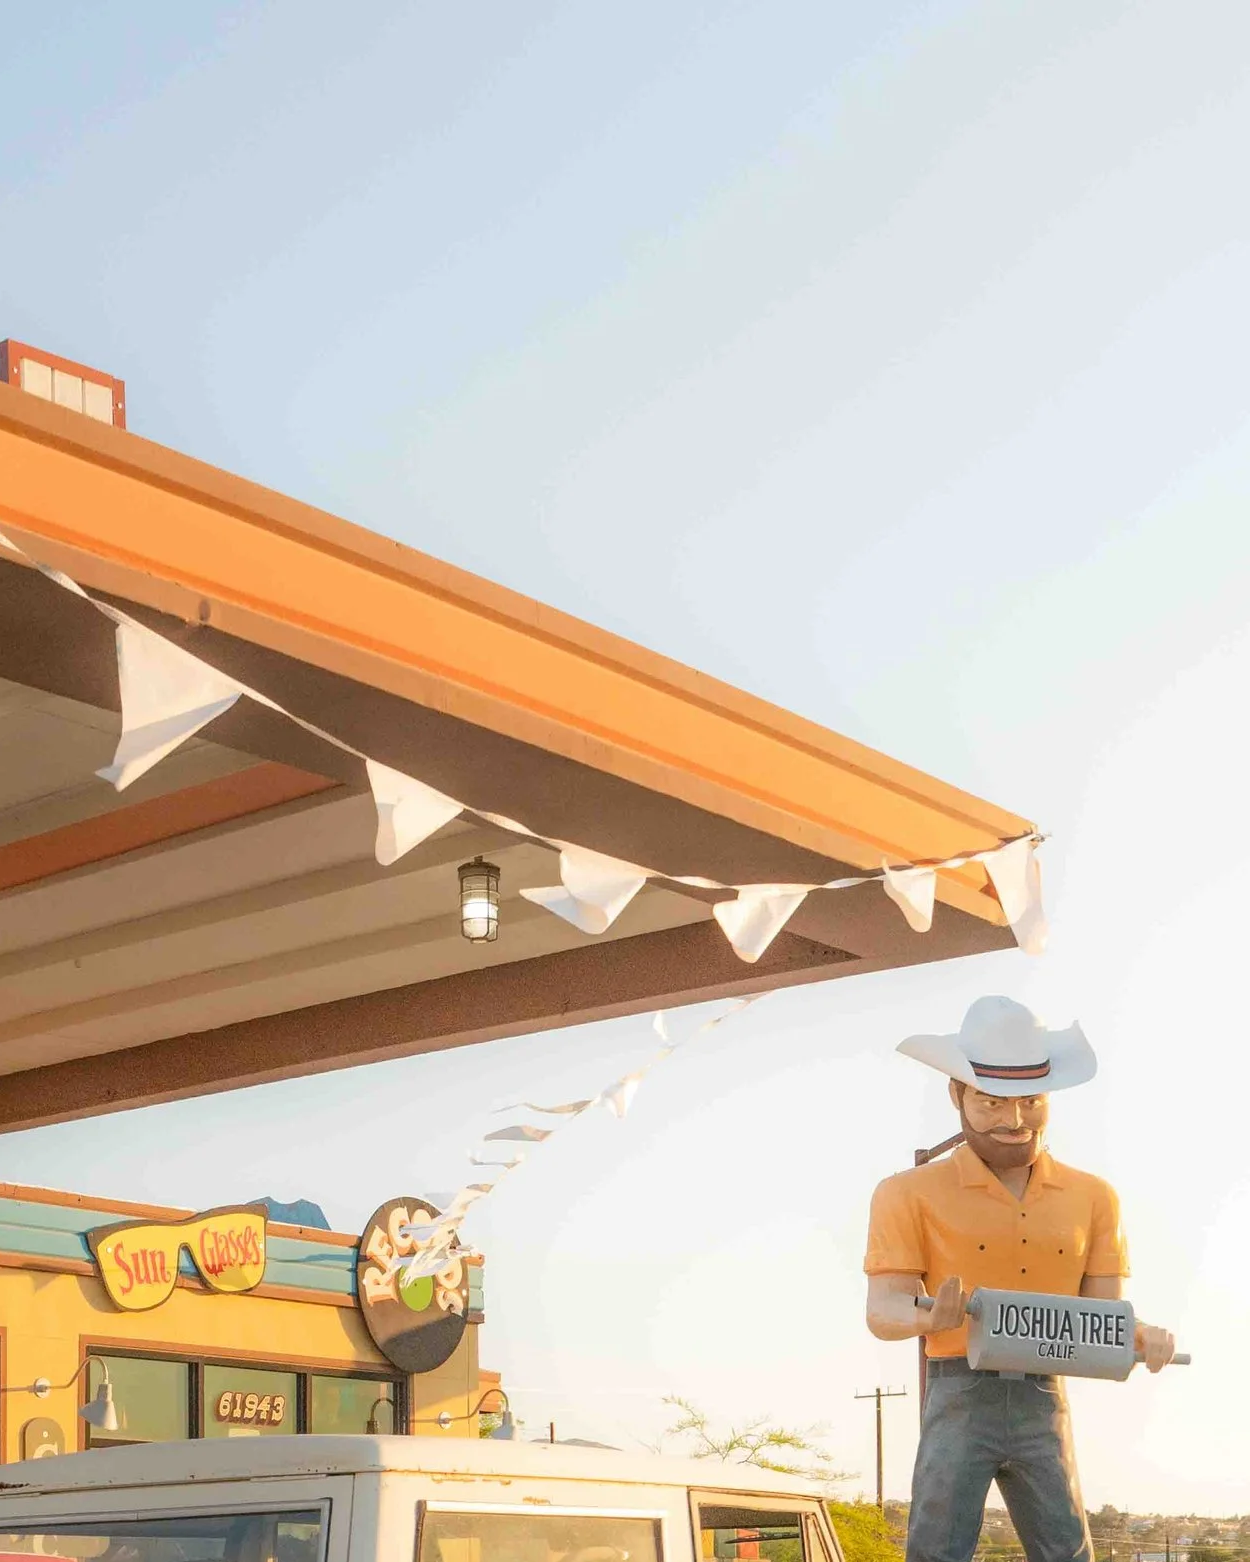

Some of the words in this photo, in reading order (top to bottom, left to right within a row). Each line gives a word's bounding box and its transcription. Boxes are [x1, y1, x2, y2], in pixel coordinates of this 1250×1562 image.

[114, 1241, 171, 1295] Sun
[200, 1226, 260, 1277] Glasses
[363, 1206, 464, 1316] RECODS
[991, 1304, 1074, 1342] JOSHUA
[1079, 1311, 1126, 1348] TREE
[1037, 1342, 1078, 1360] CALIF.
[218, 1391, 285, 1423] 61943
